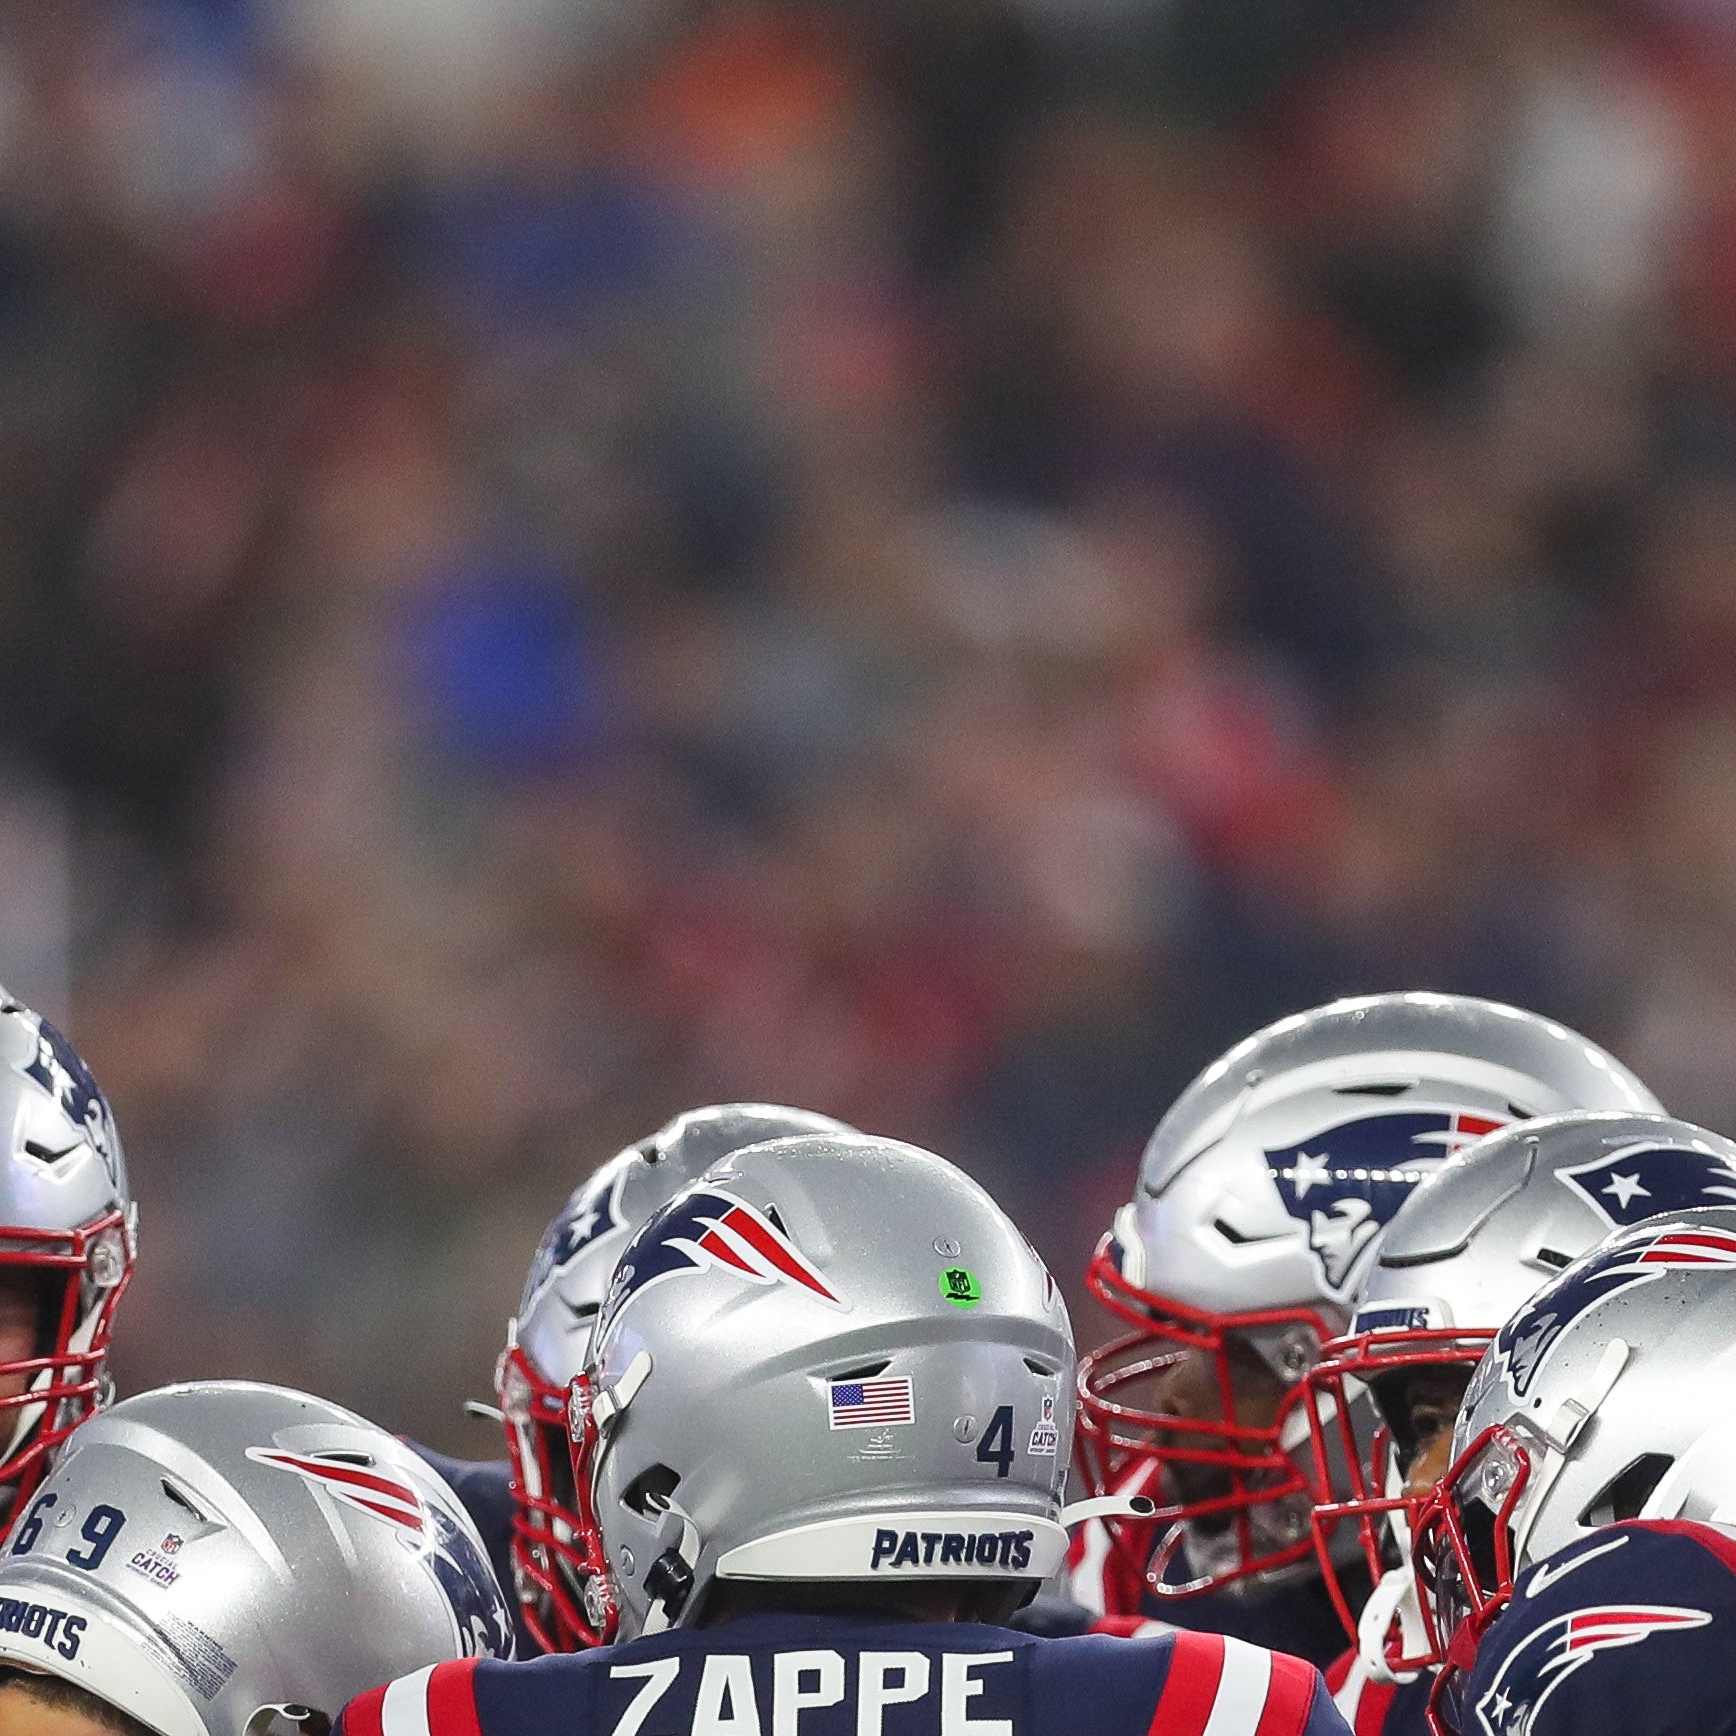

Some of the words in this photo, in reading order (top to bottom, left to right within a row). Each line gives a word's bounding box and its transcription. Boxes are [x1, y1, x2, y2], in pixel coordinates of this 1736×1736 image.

[976, 1405, 1015, 1478] 4
[12, 1493, 58, 1556] 6
[65, 1504, 127, 1571] 9
[871, 1528, 1034, 1570] PATRIOTS
[131, 1552, 181, 1585] CATCH
